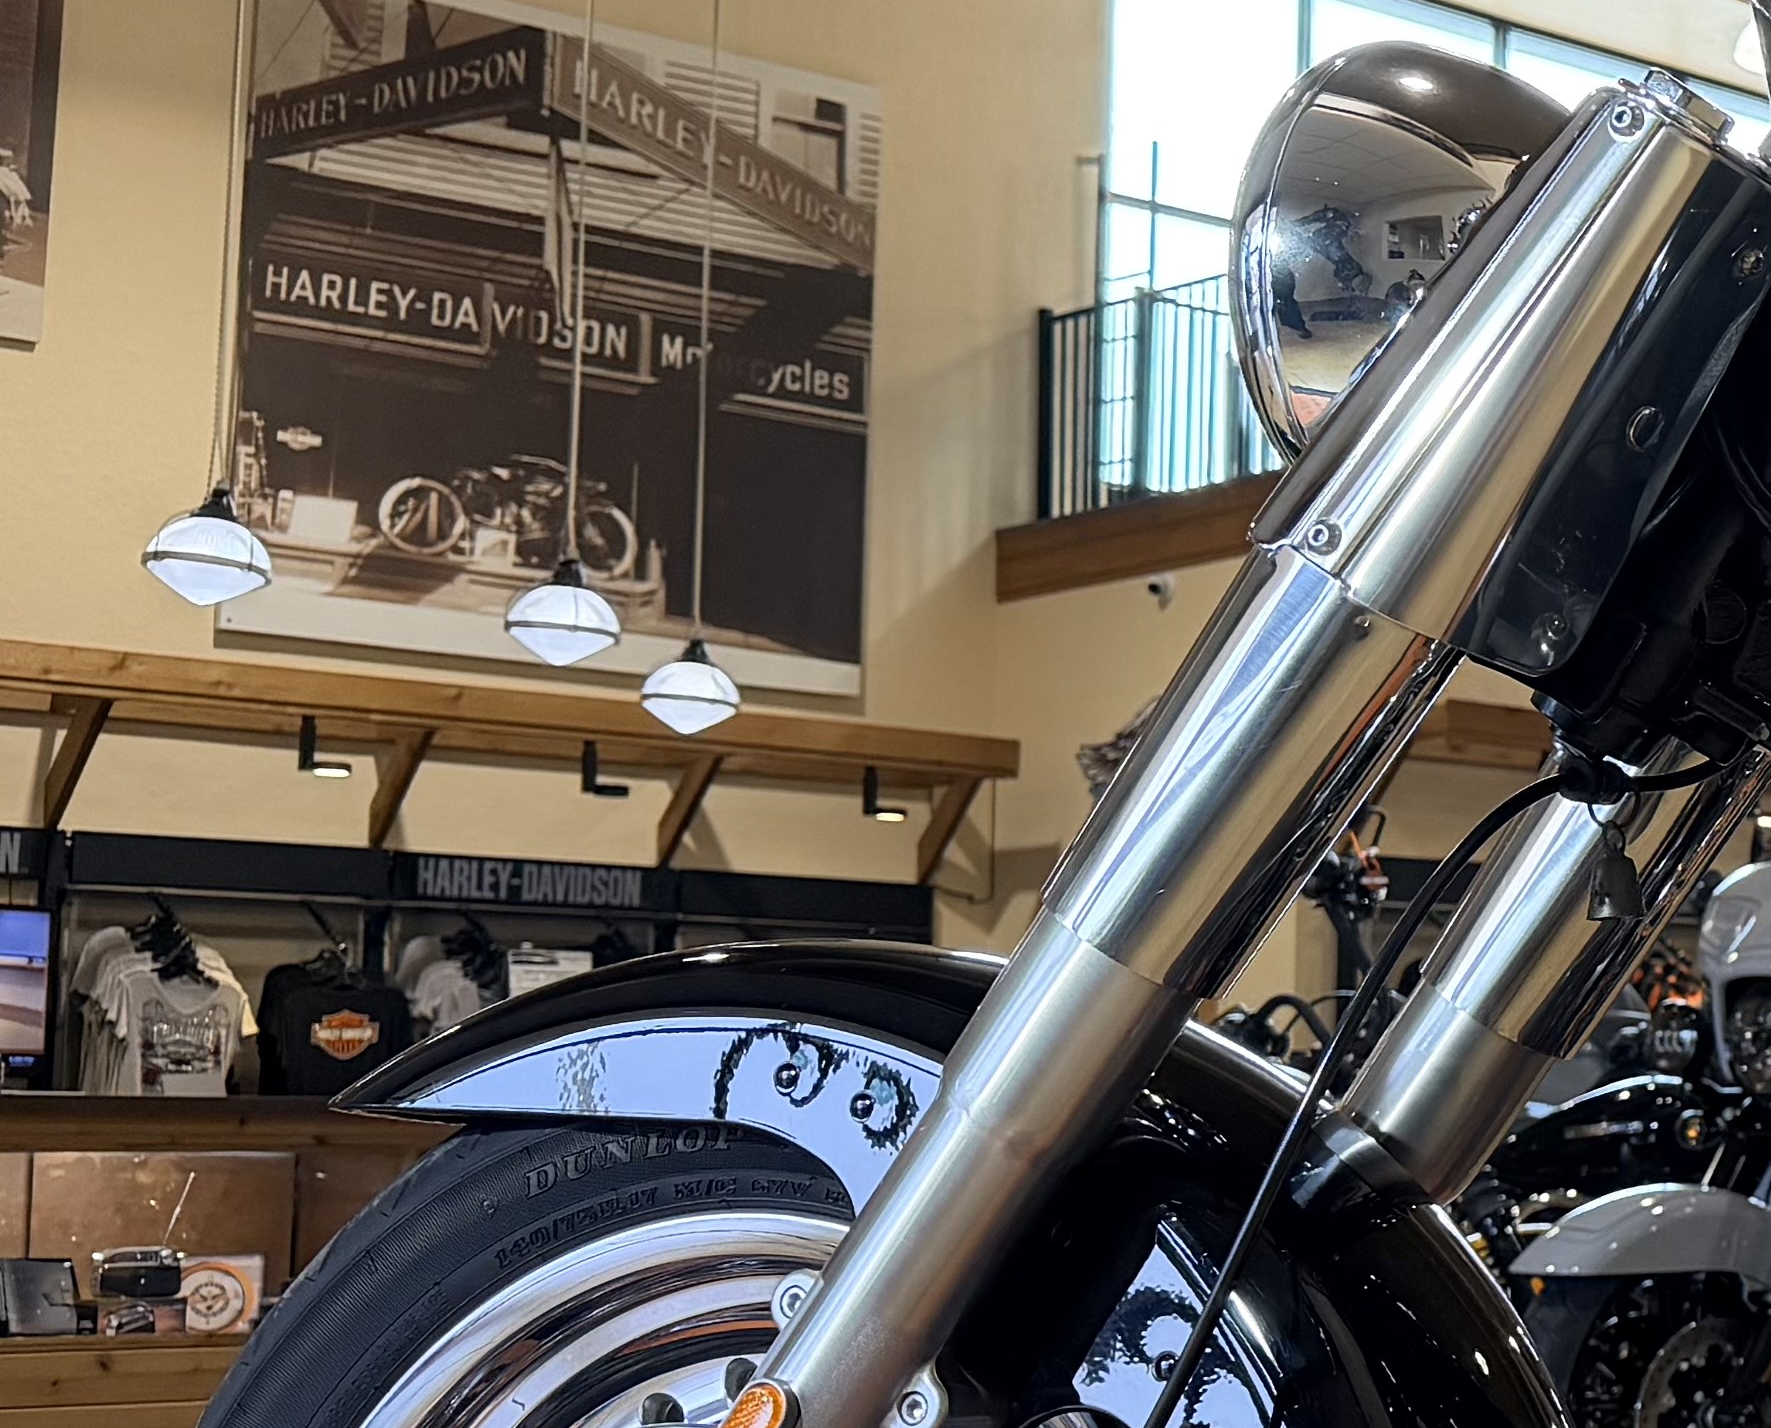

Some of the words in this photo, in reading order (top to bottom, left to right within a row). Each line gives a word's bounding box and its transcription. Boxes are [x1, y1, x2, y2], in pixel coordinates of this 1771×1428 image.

[259, 48, 528, 140] HARLEY-DAVIDSON
[416, 859, 642, 908] HARLEY-DAVIDSON
[524, 1125, 744, 1199] DUNLOP
